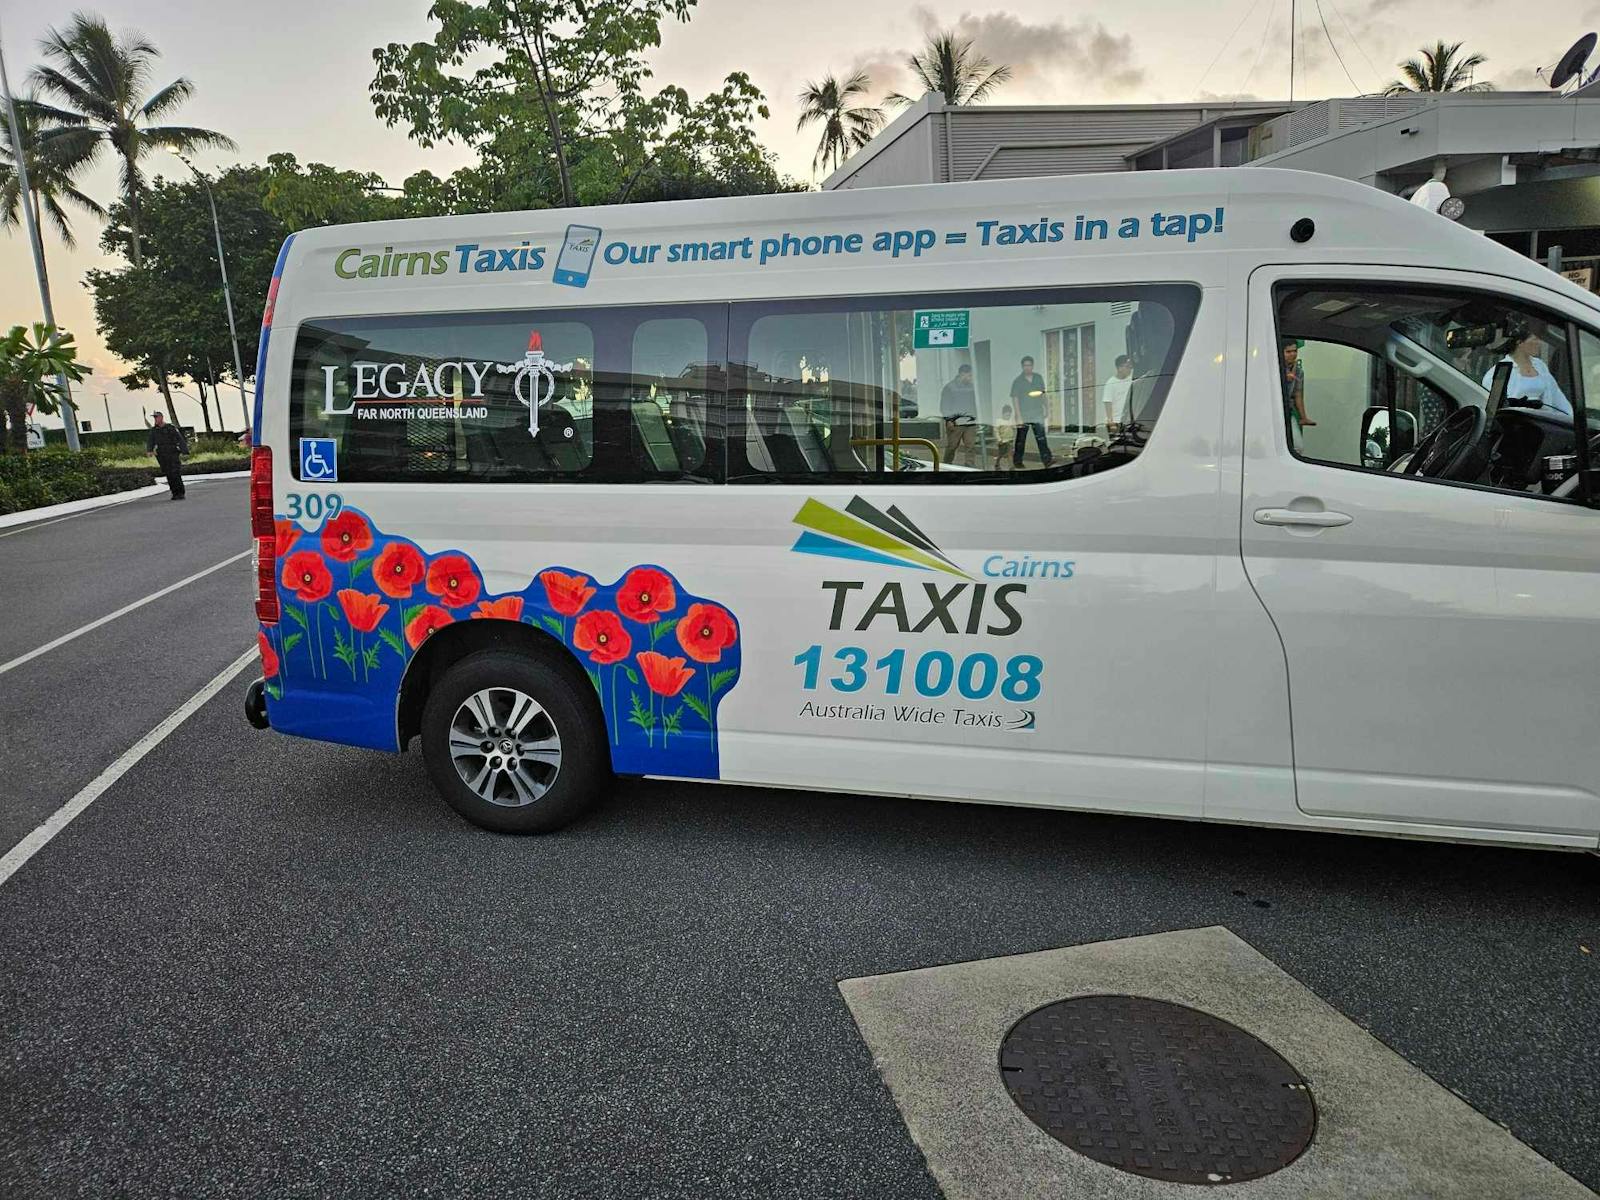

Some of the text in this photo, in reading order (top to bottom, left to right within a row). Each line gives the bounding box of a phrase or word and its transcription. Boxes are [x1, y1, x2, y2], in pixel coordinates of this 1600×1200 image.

[569, 244, 590, 253] TAXIS
[603, 207, 1225, 265] Our smart phone app = Taxis in a tap!
[334, 241, 547, 280] Cairns Taxis
[320, 361, 494, 415] LEGACY
[357, 406, 488, 420] FAR NORTH QUEENSLAND
[286, 493, 343, 519] 309
[982, 554, 1076, 579] Cairns
[821, 580, 1027, 636] TAXIS
[793, 644, 1045, 702] 131008
[799, 701, 1004, 728] Australia Wide Taxis
